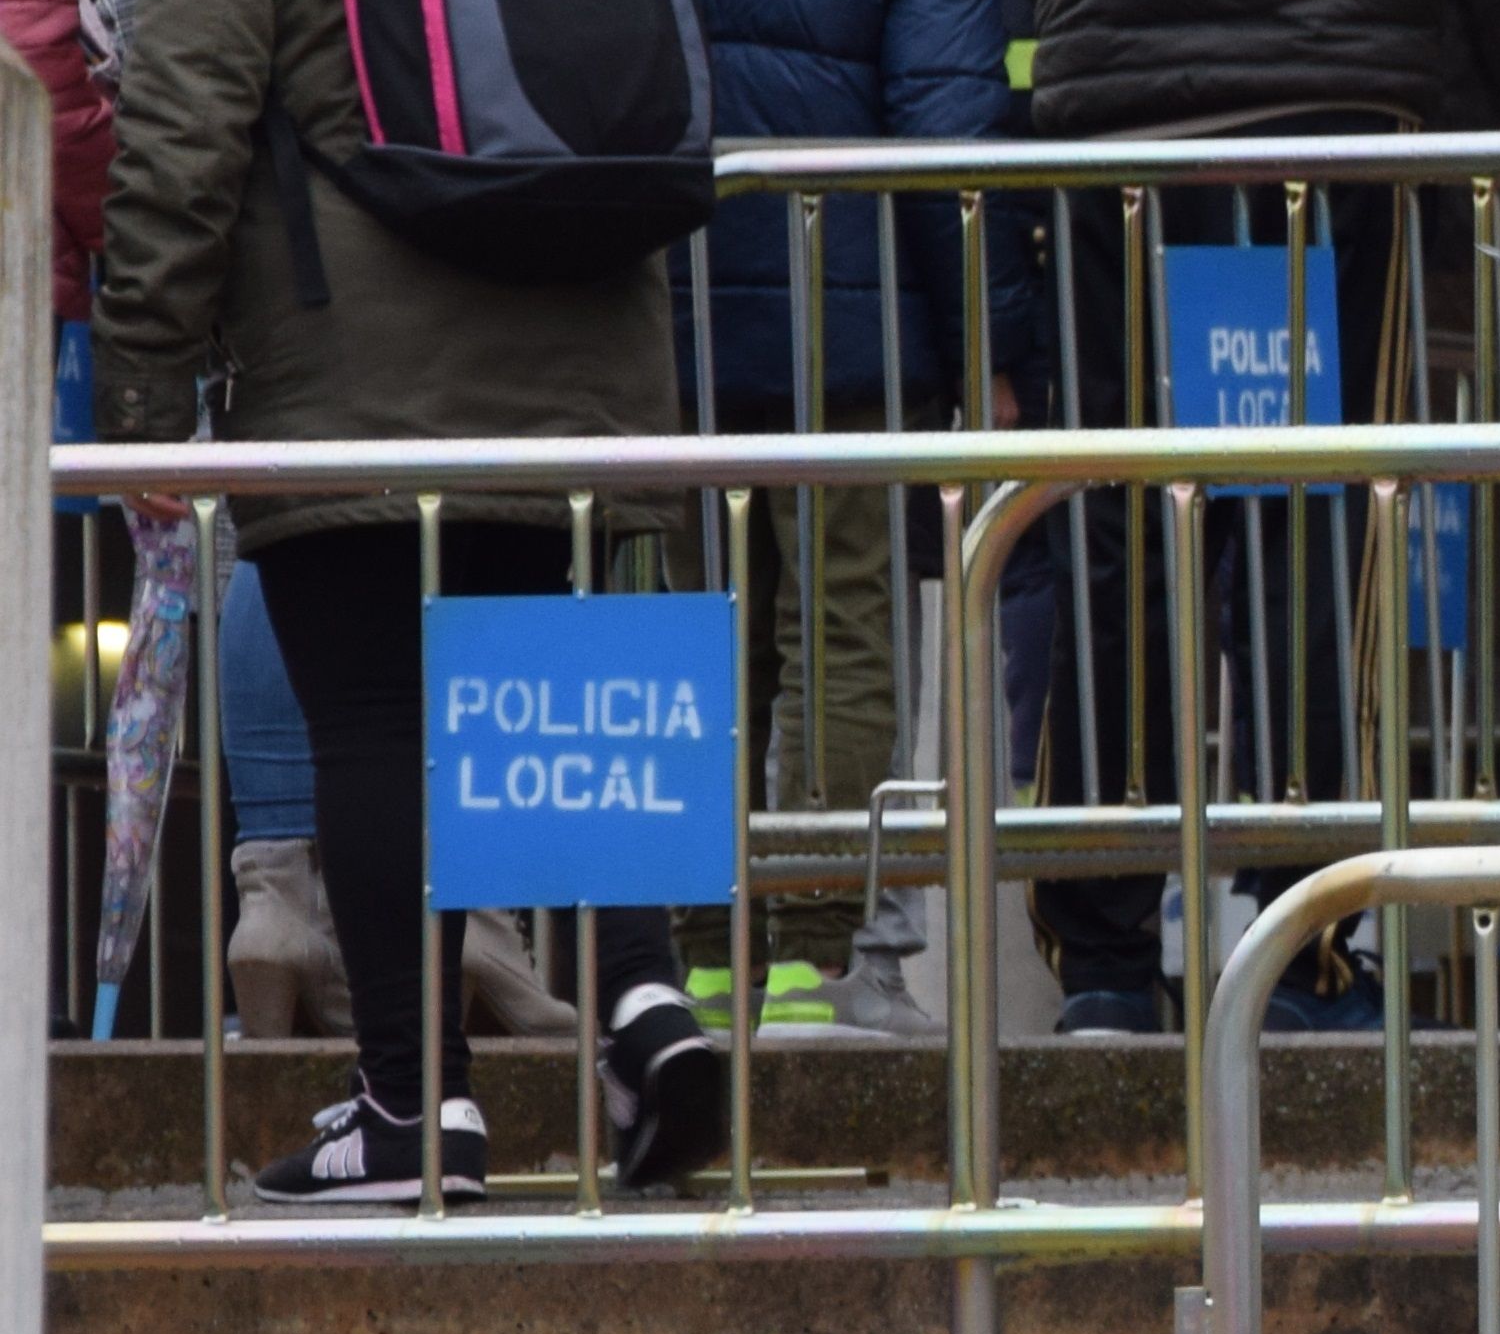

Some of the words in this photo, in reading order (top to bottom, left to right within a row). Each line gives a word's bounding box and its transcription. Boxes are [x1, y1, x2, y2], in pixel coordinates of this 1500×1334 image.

[1209, 327, 1321, 375] POLICA
[447, 677, 702, 739] POLICIA
[459, 754, 685, 813] LOCAL
